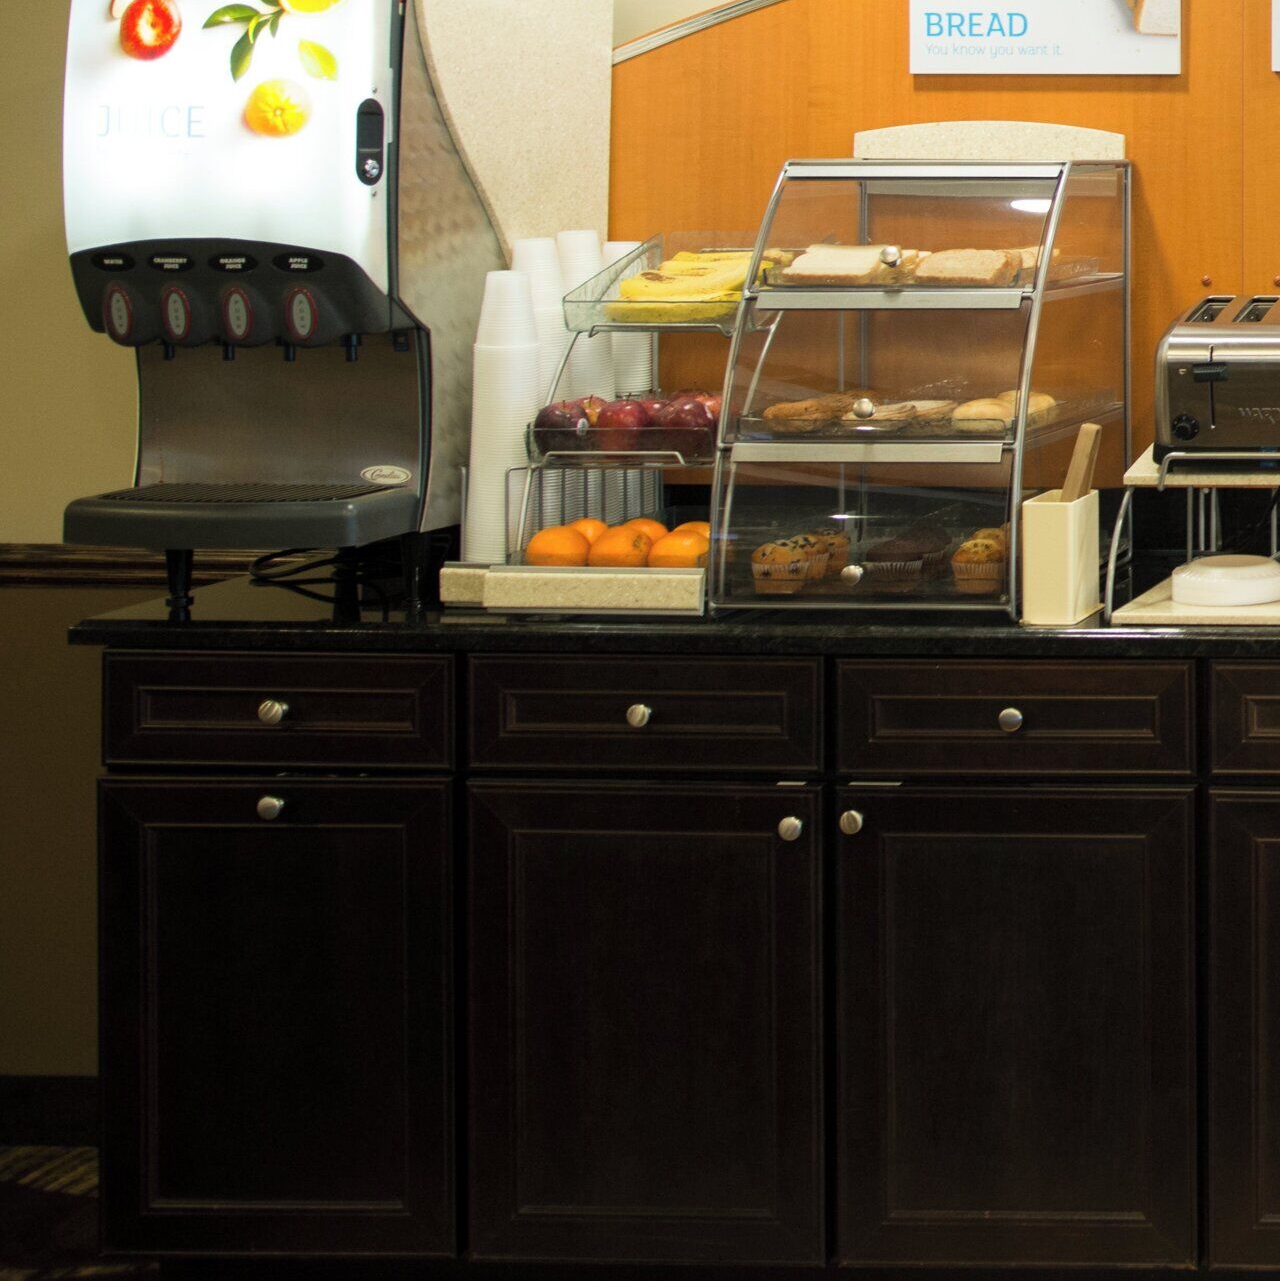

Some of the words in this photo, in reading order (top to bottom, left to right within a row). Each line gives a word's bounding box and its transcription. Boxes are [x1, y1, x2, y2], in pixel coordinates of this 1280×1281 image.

[924, 12, 1028, 37] BREAD
[926, 43, 948, 56] You
[952, 43, 985, 56] know
[990, 45, 1014, 60] you
[1018, 44, 1049, 56] want
